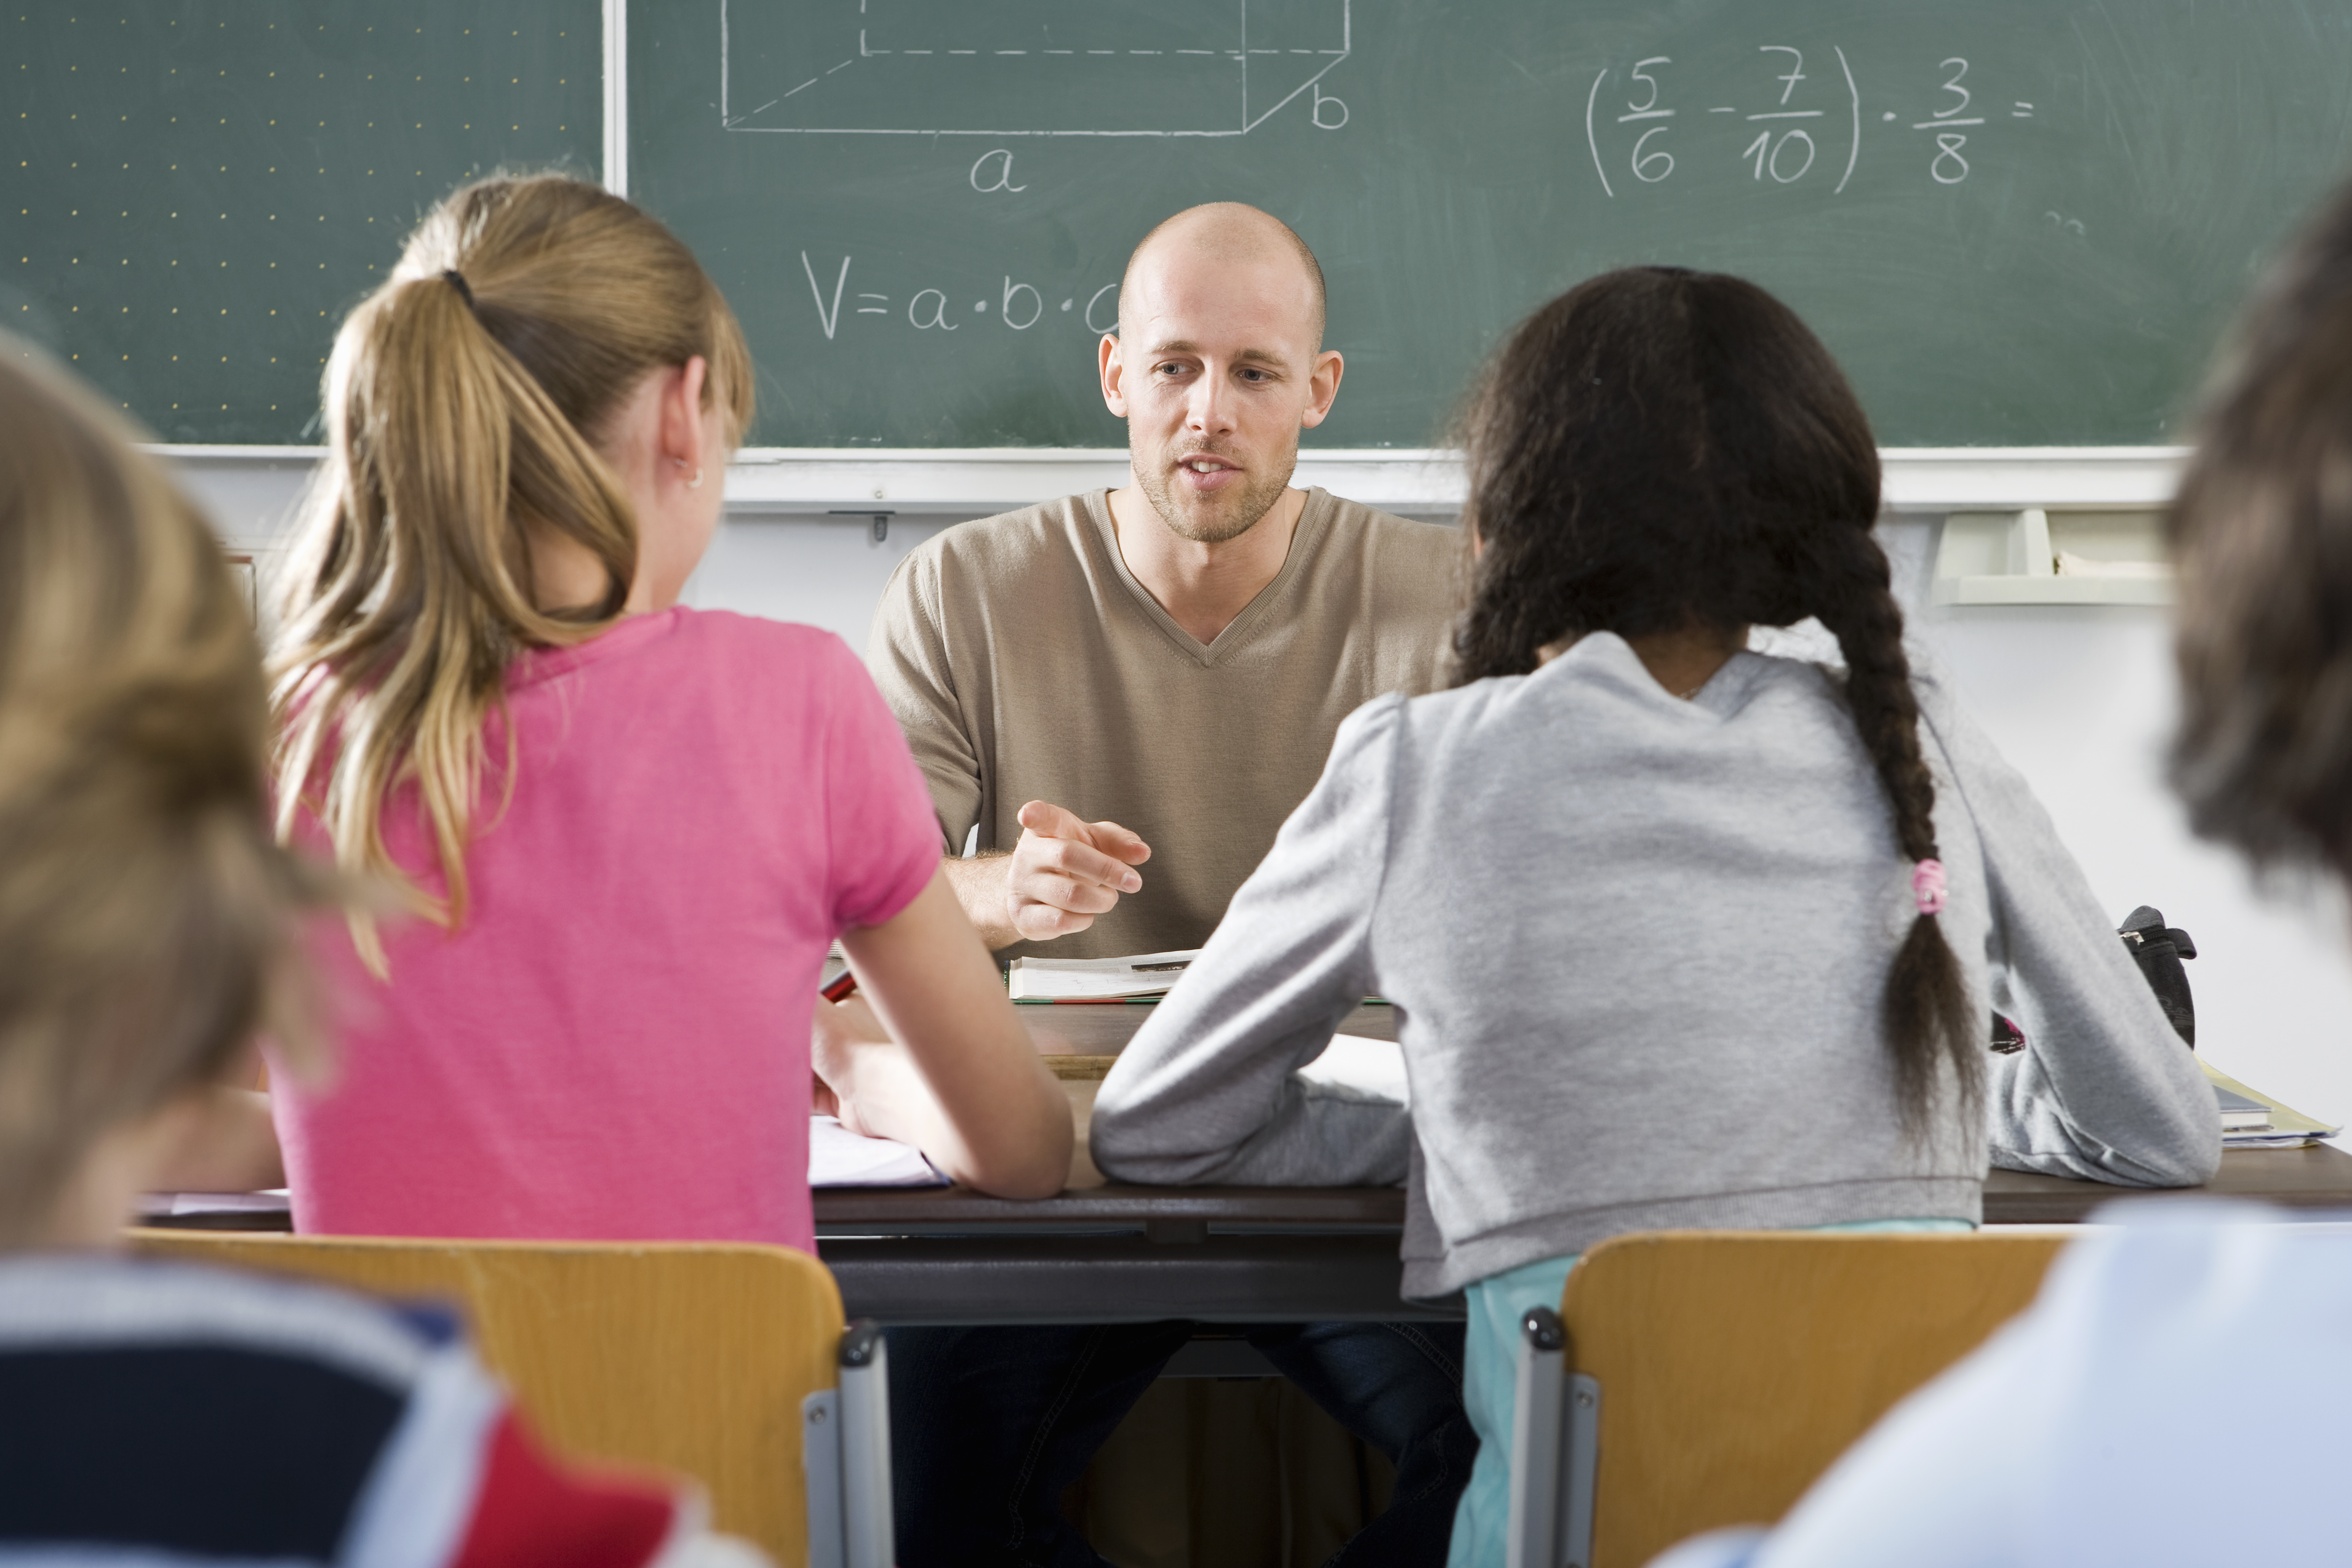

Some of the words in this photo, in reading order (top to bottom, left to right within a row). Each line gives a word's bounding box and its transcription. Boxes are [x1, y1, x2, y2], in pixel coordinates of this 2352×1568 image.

[1312, 83, 1349, 129] b
[1628, 56, 1672, 112] 5
[1759, 45, 1807, 105] 7
[1932, 57, 1970, 118] 3
[969, 149, 1027, 193] a
[1631, 127, 1675, 182] 6
[1743, 129, 1815, 183] 10
[1931, 133, 1969, 184] 8
